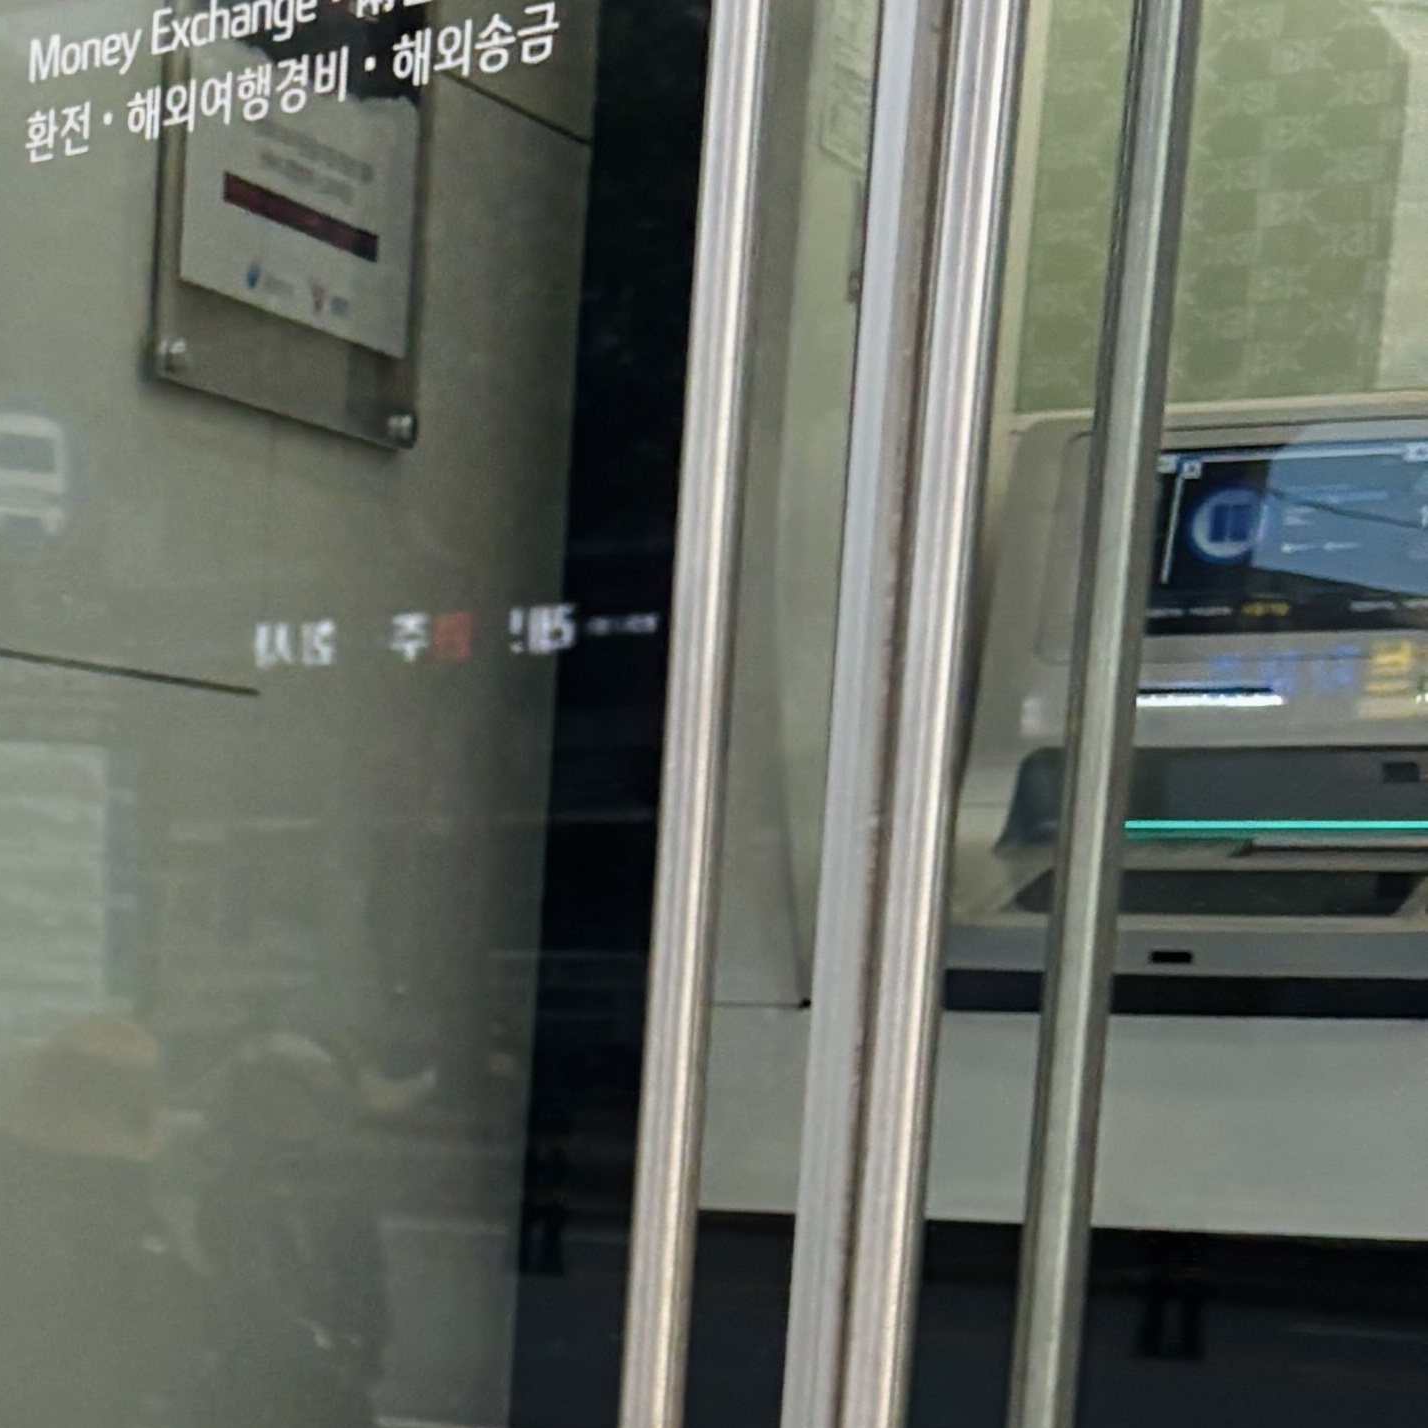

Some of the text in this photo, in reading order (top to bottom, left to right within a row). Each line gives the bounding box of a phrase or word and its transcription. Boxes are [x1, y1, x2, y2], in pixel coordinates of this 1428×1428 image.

[25, 1, 560, 163] 환전 해외여행경비 해외송금
[28, 0, 317, 83] Money Exchange
